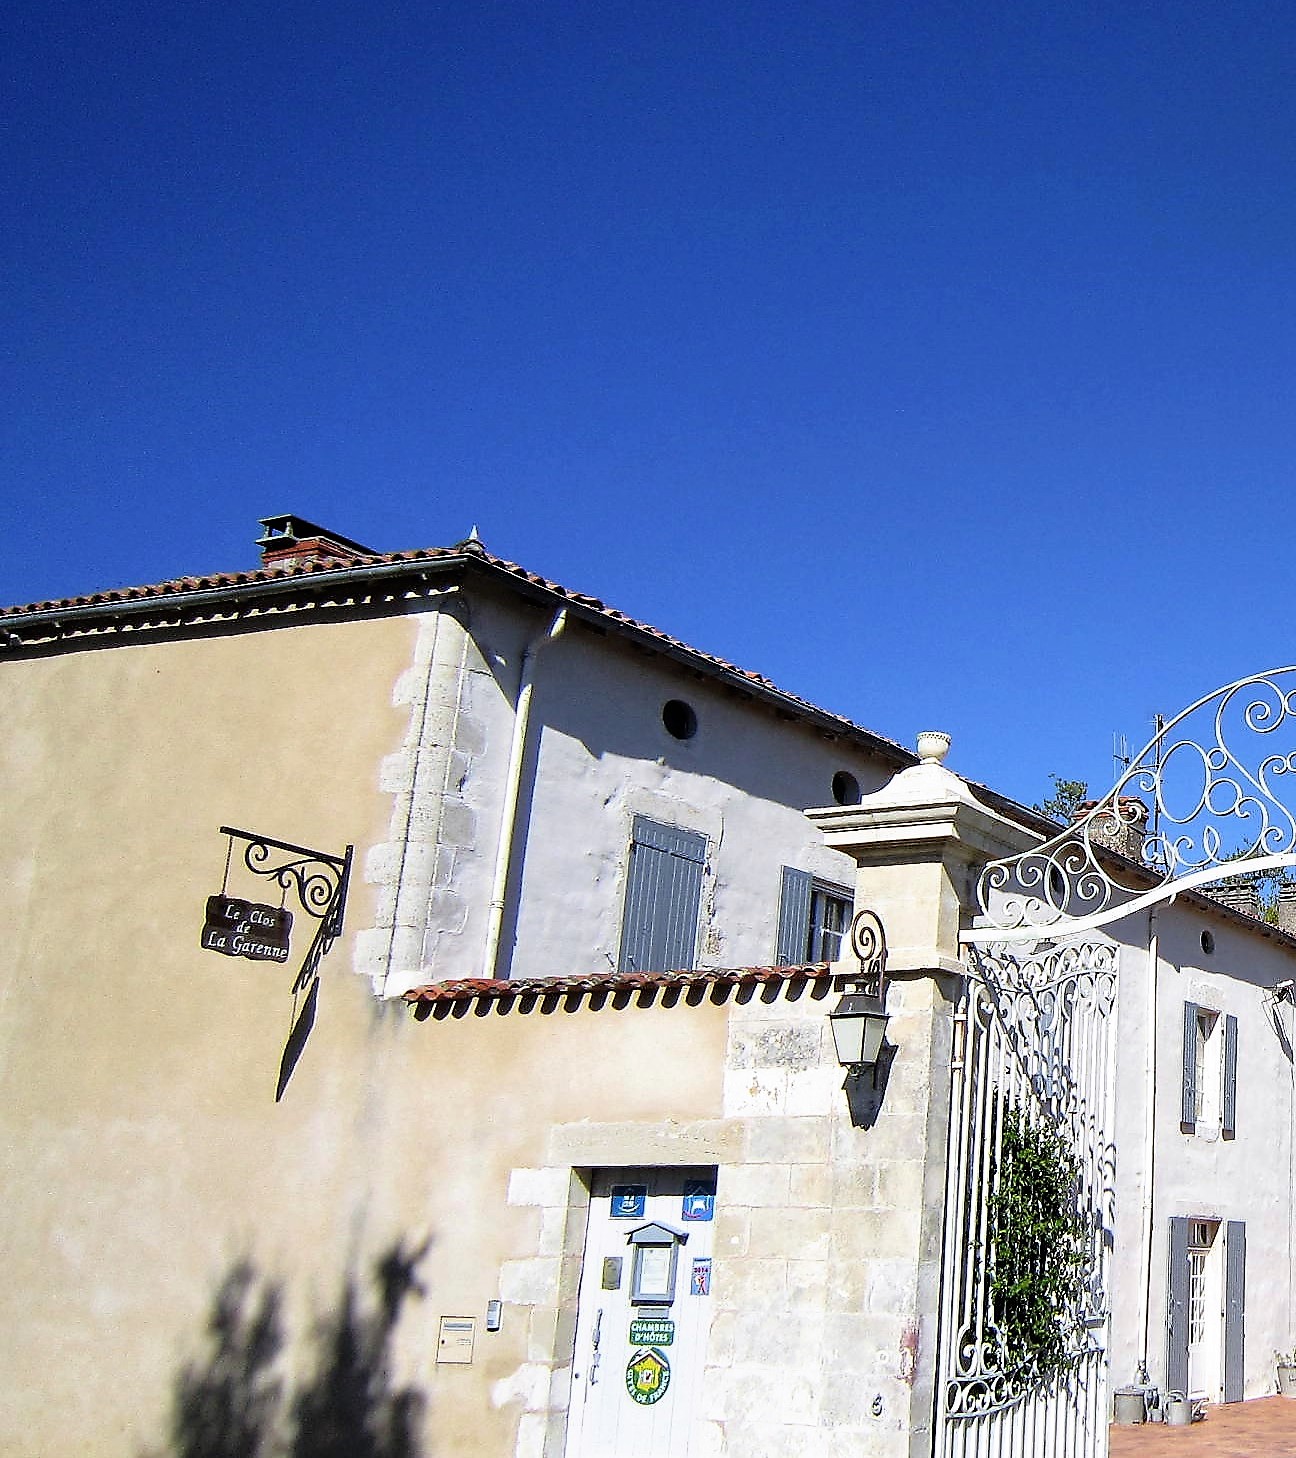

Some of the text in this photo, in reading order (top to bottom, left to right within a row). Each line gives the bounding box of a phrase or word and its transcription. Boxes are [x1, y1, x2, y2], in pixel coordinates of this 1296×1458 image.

[225, 904, 276, 927] Le Clos
[236, 920, 251, 934] de
[207, 931, 288, 958] La Garenne
[631, 1323, 674, 1332] CHAMBRES
